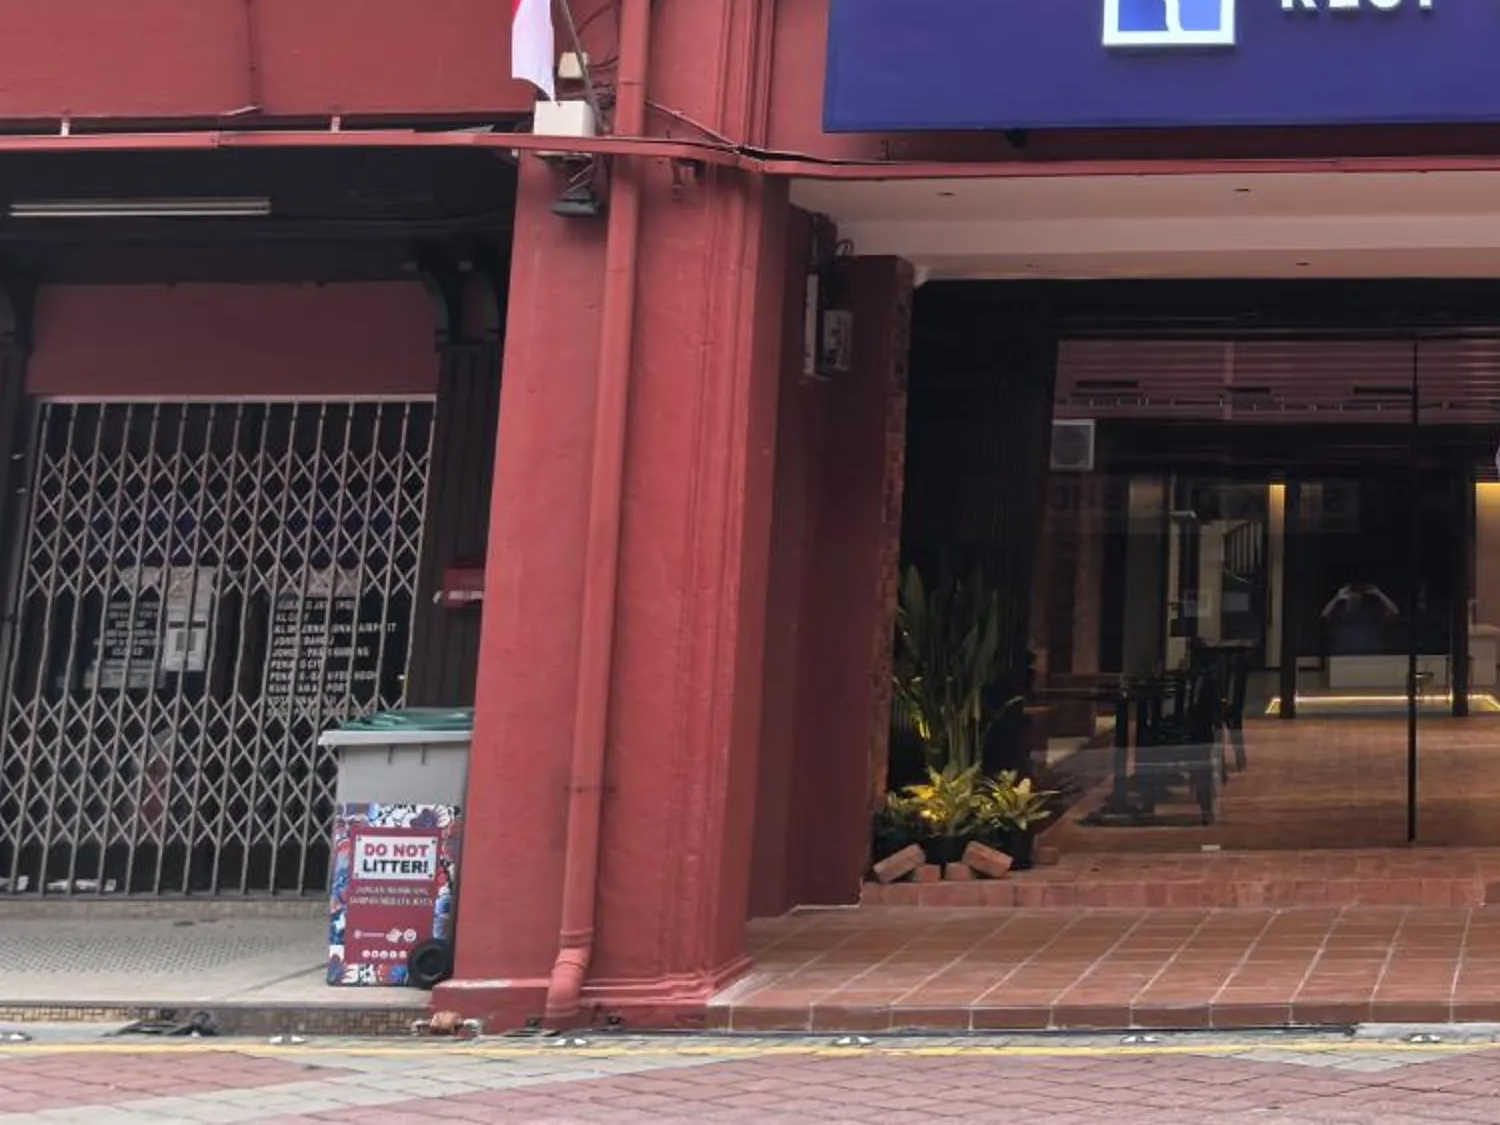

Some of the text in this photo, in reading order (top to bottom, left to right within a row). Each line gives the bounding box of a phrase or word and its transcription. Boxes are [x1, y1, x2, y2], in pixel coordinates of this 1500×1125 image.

[364, 844, 430, 859] DO NOT
[363, 859, 429, 874] LITTER!
